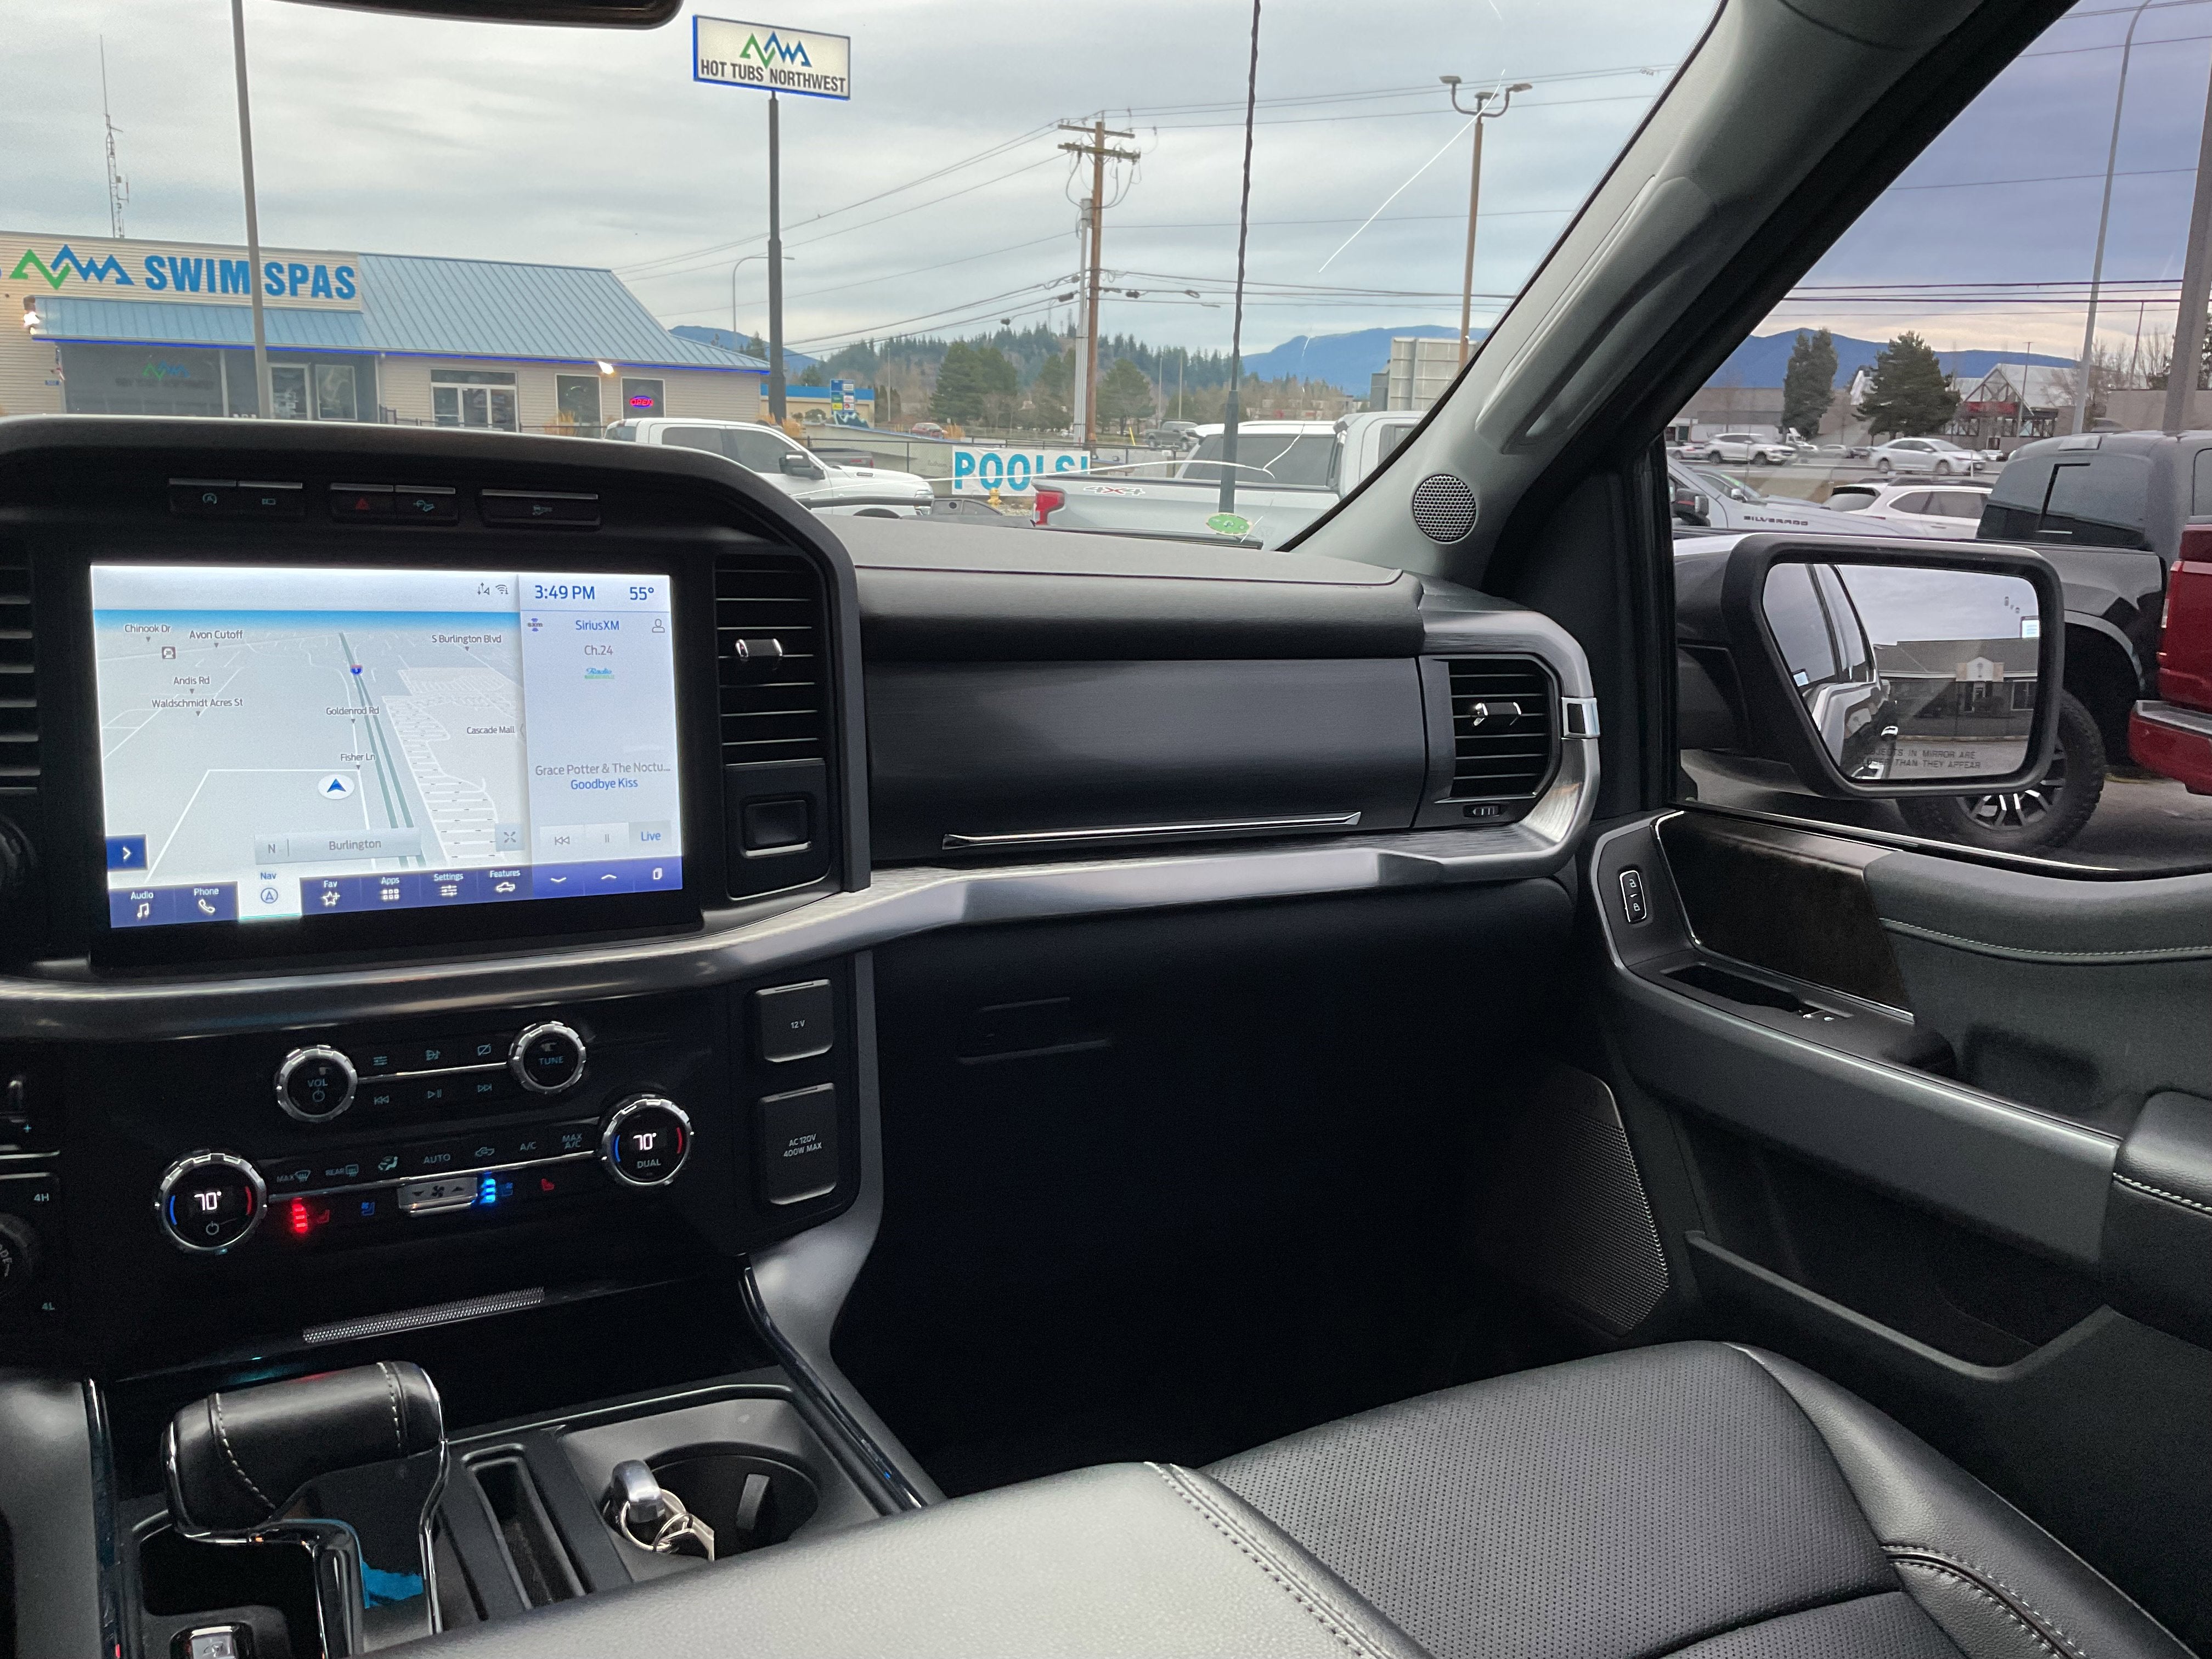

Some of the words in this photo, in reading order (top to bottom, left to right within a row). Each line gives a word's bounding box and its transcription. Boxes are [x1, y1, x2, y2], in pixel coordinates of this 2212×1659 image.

[701, 59, 727, 77] HOT
[730, 63, 764, 82] TUBS
[770, 67, 846, 93] NORTHWEST
[144, 255, 251, 295] SWIM
[264, 261, 357, 300] SPAS
[629, 398, 654, 407] OPEN
[1743, 515, 1809, 526] SILVERADO
[534, 585, 568, 599] 3:49
[572, 585, 595, 600] PM
[630, 586, 654, 600] 55°
[124, 624, 160, 633] Chinook
[161, 624, 171, 633] Dr
[575, 620, 620, 631] SiriusXM
[189, 630, 212, 639] Avon
[214, 630, 243, 639] Cutoff
[431, 635, 437, 643] S
[438, 635, 482, 645] Burlington
[483, 635, 502, 644] Blvd
[584, 645, 613, 656] Ch.24
[173, 676, 197, 685] Andis
[198, 676, 211, 685] Rd
[151, 698, 208, 708] Waldschmidt
[210, 699, 232, 707] Acres
[234, 698, 244, 707] St
[326, 707, 367, 716] Goldenrod
[369, 706, 380, 715] Rd
[466, 726, 498, 735] Cascade
[499, 725, 515, 734] Mall
[340, 753, 364, 761] Fisher
[365, 753, 376, 761] Ln
[1922, 750, 1955, 758] MIRROR
[1895, 759, 1918, 767] THAN
[535, 765, 565, 776] Grace
[567, 763, 600, 775] Potter
[601, 764, 610, 774] &
[612, 763, 631, 774] The
[571, 778, 616, 790] Goodbye
[618, 777, 639, 788] Kiss
[641, 831, 662, 842] Live
[268, 843, 276, 854] N
[329, 839, 382, 851] Burlington
[130, 890, 154, 900] Audio
[194, 887, 219, 896] Phone
[260, 871, 277, 881] Nav
[323, 879, 338, 888] Fav
[381, 876, 400, 885] Apps
[433, 872, 464, 881] Settings
[489, 870, 521, 878] Features
[791, 1020, 800, 1029] 12
[799, 1019, 805, 1028] V
[538, 1056, 565, 1066] TUNE
[307, 1078, 328, 1088] VOL
[562, 1132, 583, 1143] MAX
[788, 1137, 799, 1148] AC
[799, 1133, 816, 1145] 120V
[520, 1141, 537, 1152] A/C
[564, 1139, 582, 1150] A/C
[783, 1146, 805, 1158] 400W
[806, 1141, 822, 1153] MAX
[423, 1153, 452, 1165] AUTO
[637, 1158, 662, 1169] DUAL
[33, 1193, 50, 1202] 4H
[42, 1302, 55, 1311] 4L
